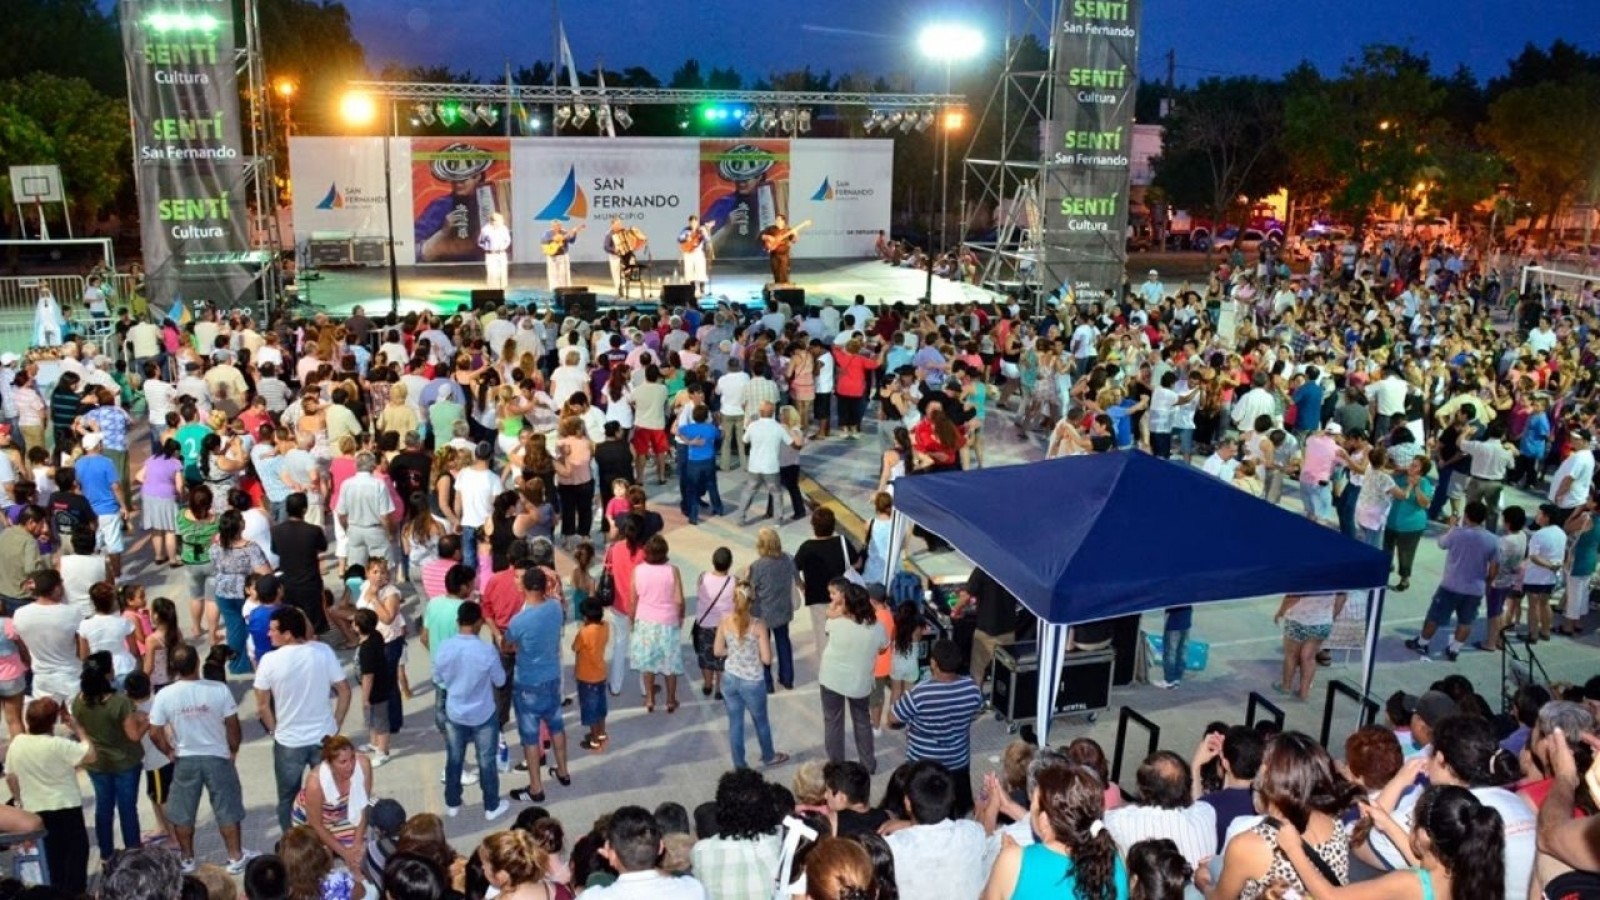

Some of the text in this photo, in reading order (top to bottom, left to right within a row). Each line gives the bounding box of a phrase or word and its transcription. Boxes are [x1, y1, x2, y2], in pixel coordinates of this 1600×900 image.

[1074, 0, 1128, 21] SENTÍ
[1063, 21, 1135, 37] San Fernando
[144, 34, 217, 65] SENTÍ
[155, 70, 209, 84] Cultura
[1069, 65, 1127, 88] SENTÍ
[1077, 91, 1116, 104] Cultura
[153, 111, 224, 140] SENTÍ
[1065, 126, 1122, 150] SENTÍ
[167, 145, 236, 159] Fernando
[1055, 153, 1128, 166] San Fernando
[593, 178, 624, 190] SAN
[159, 190, 231, 220] SENTÍ
[593, 195, 680, 207] FERNANDO
[1061, 192, 1119, 216] SENTÍ
[593, 212, 645, 220] MUNICIPIO
[171, 225, 223, 239] Cultura
[1068, 219, 1108, 231] Cultura
[185, 437, 198, 458] 2
